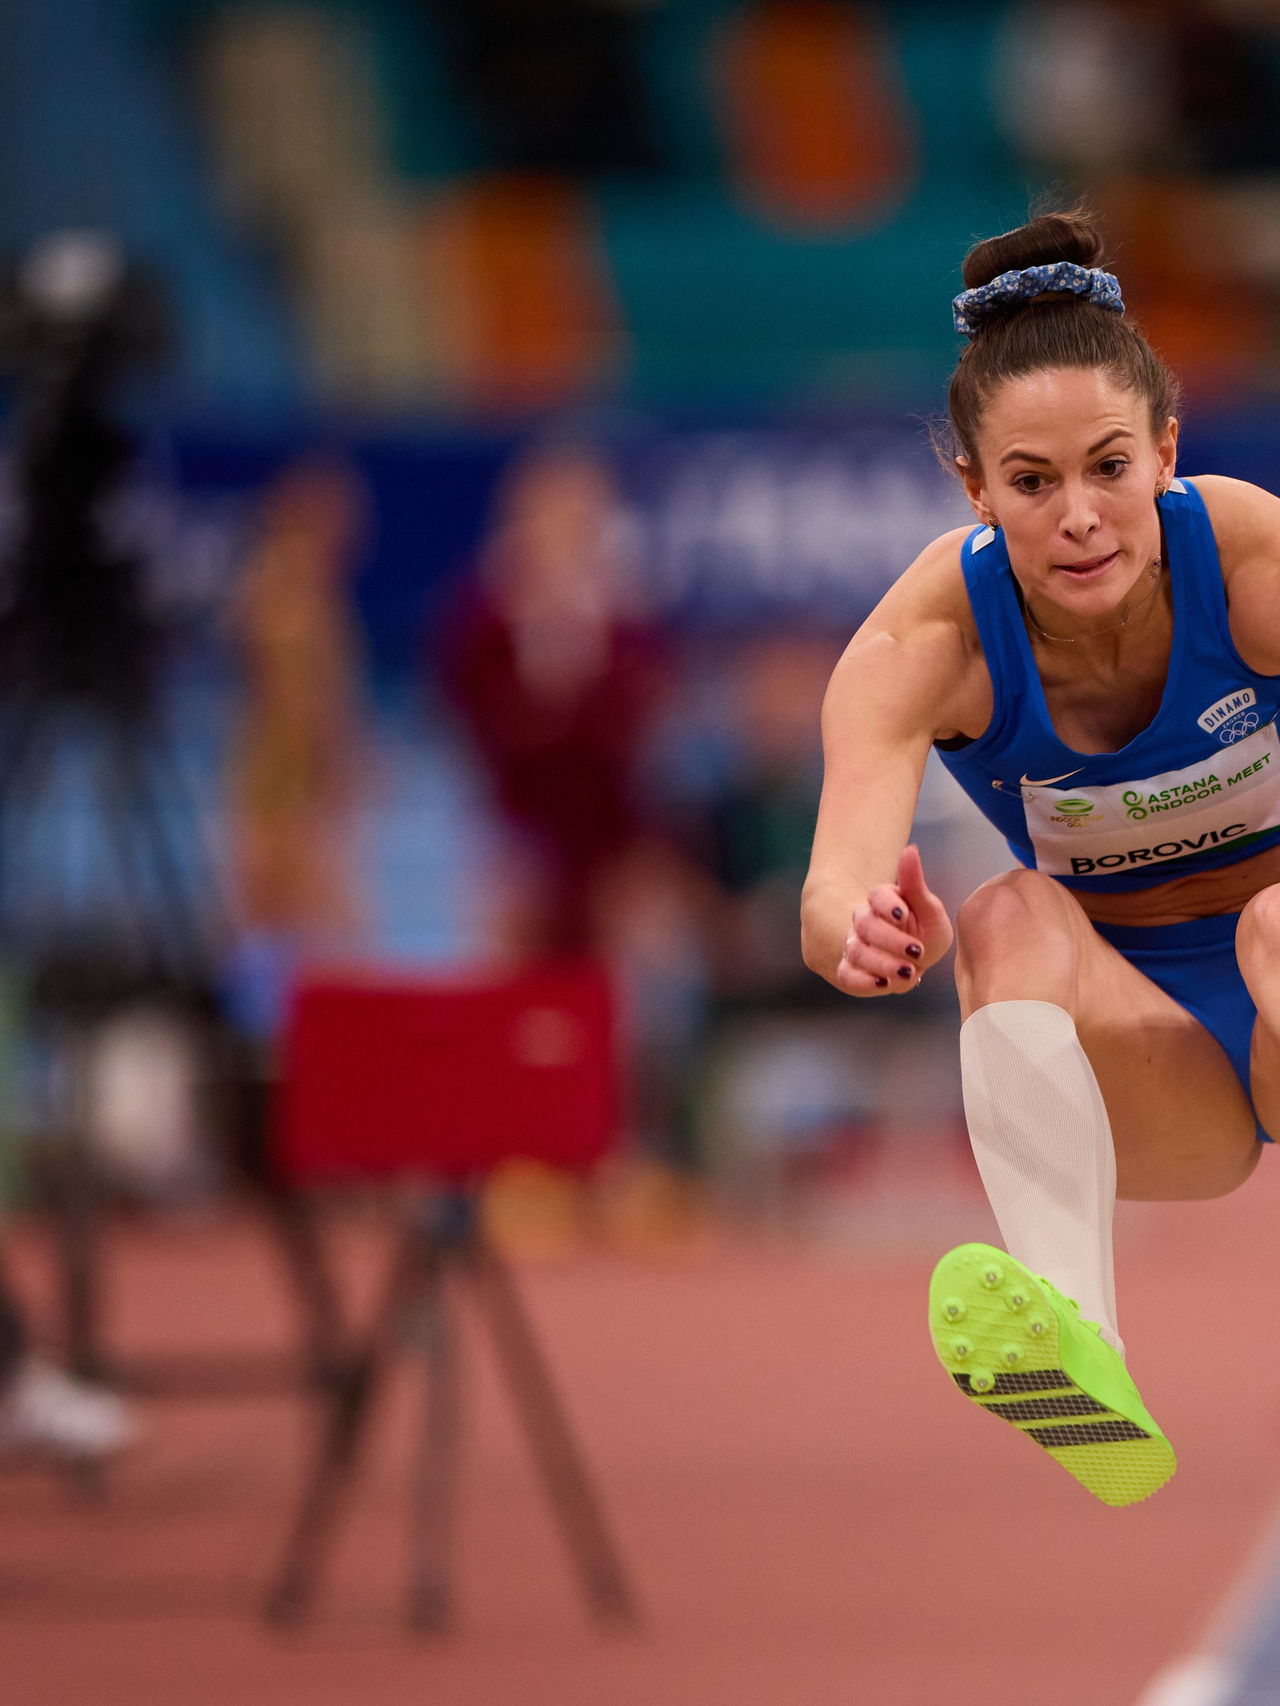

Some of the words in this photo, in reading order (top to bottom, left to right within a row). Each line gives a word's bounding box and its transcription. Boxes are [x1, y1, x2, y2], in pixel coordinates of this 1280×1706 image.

[1203, 692, 1250, 728] DINAMO
[1147, 773, 1220, 805] ASTANA
[1149, 783, 1223, 814] INDOOR
[1226, 752, 1272, 787] MEET
[1070, 823, 1248, 875] BOROVIC
